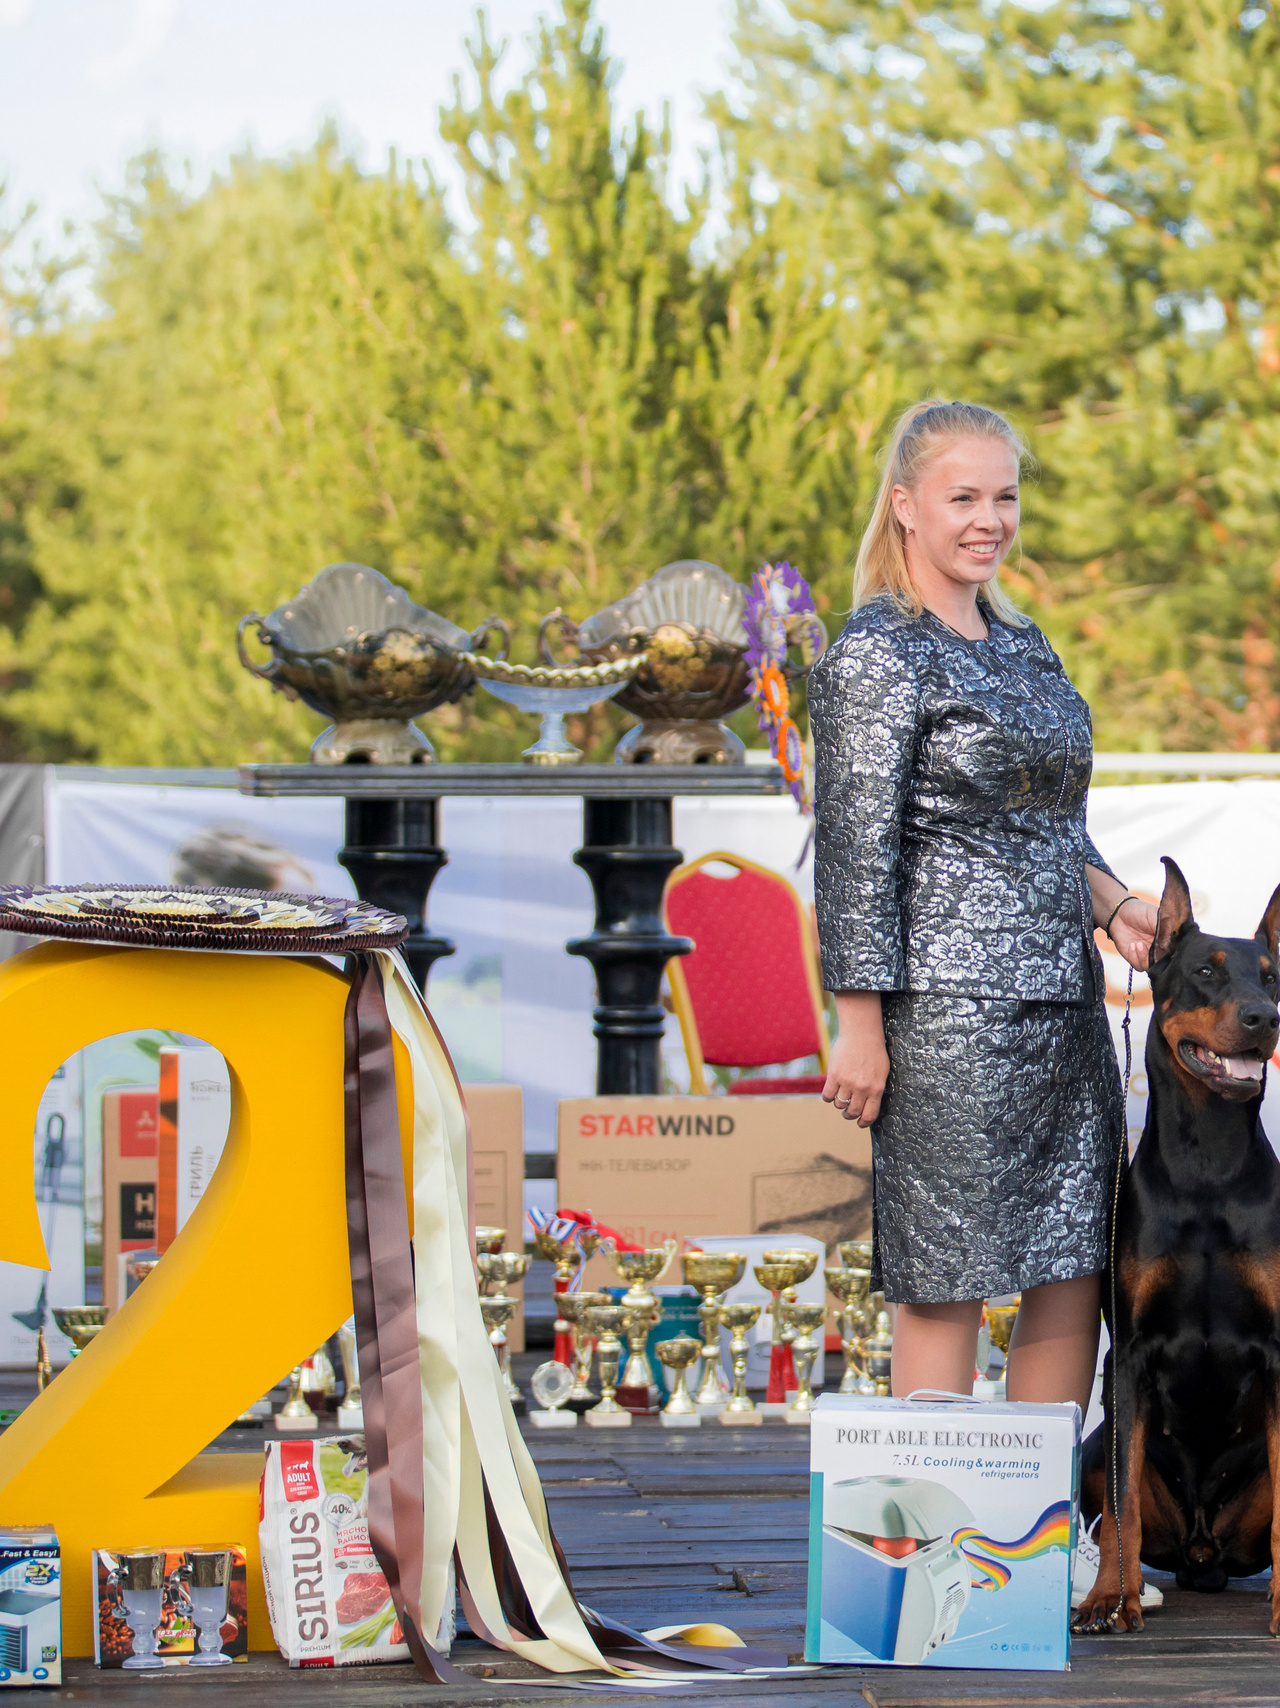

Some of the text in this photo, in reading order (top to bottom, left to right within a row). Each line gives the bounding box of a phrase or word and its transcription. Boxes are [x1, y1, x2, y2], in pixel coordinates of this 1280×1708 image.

[579, 1114, 736, 1137] STARWIND
[0, 940, 410, 1656] 2
[836, 1427, 1043, 1450] PORT ABLE ELECTRONIC
[892, 1453, 1041, 1472] 7.5L Cooling&warming
[287, 1472, 311, 1483] ADULT
[980, 1469, 1040, 1480] refrigerators
[331, 1503, 352, 1514] 40%
[336, 1526, 368, 1537] МЯСНО
[33, 1549, 58, 1557] Easy!
[25, 1564, 53, 1578] 2X
[289, 1511, 329, 1642] SIRIUS
[300, 1643, 332, 1653] PREMIUM
